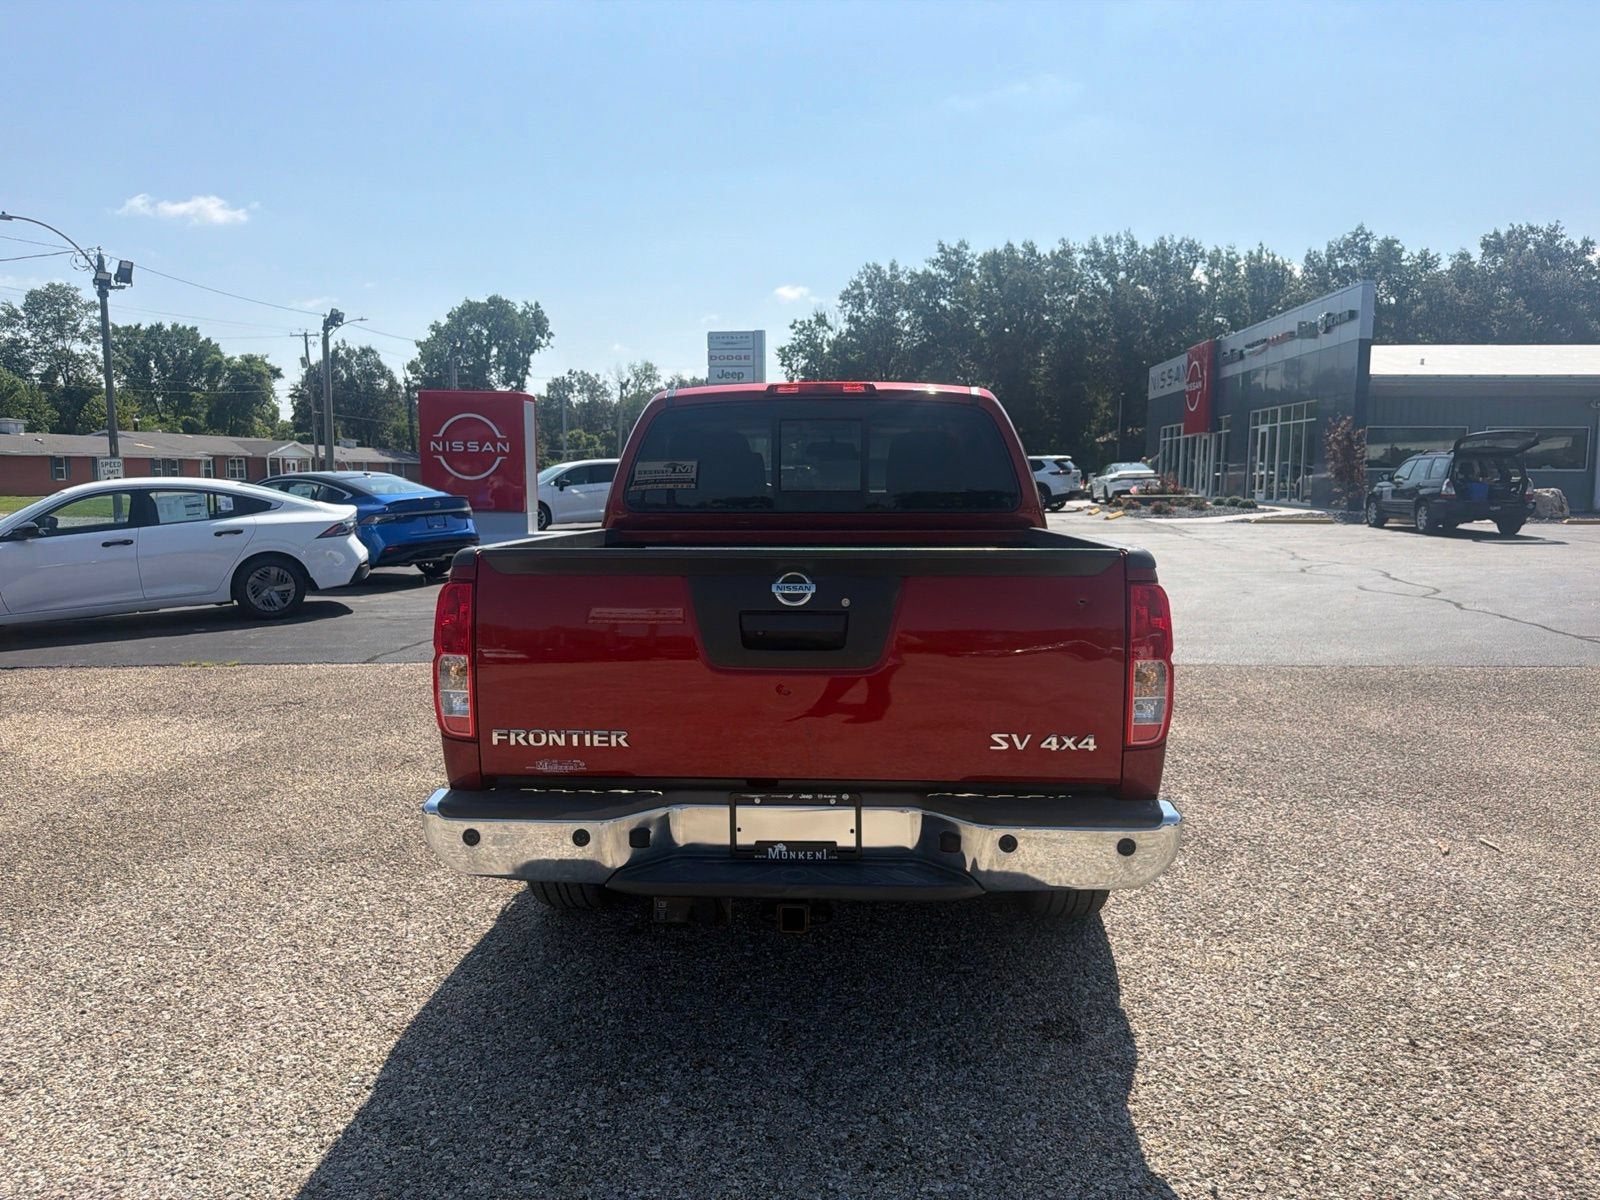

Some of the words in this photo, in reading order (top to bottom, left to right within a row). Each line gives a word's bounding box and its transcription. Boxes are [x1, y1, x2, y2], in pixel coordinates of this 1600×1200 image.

[717, 369, 744, 381] Jeep
[430, 441, 510, 453] NISSAN
[491, 729, 630, 748] FRONTIER
[989, 733, 1032, 751] SV
